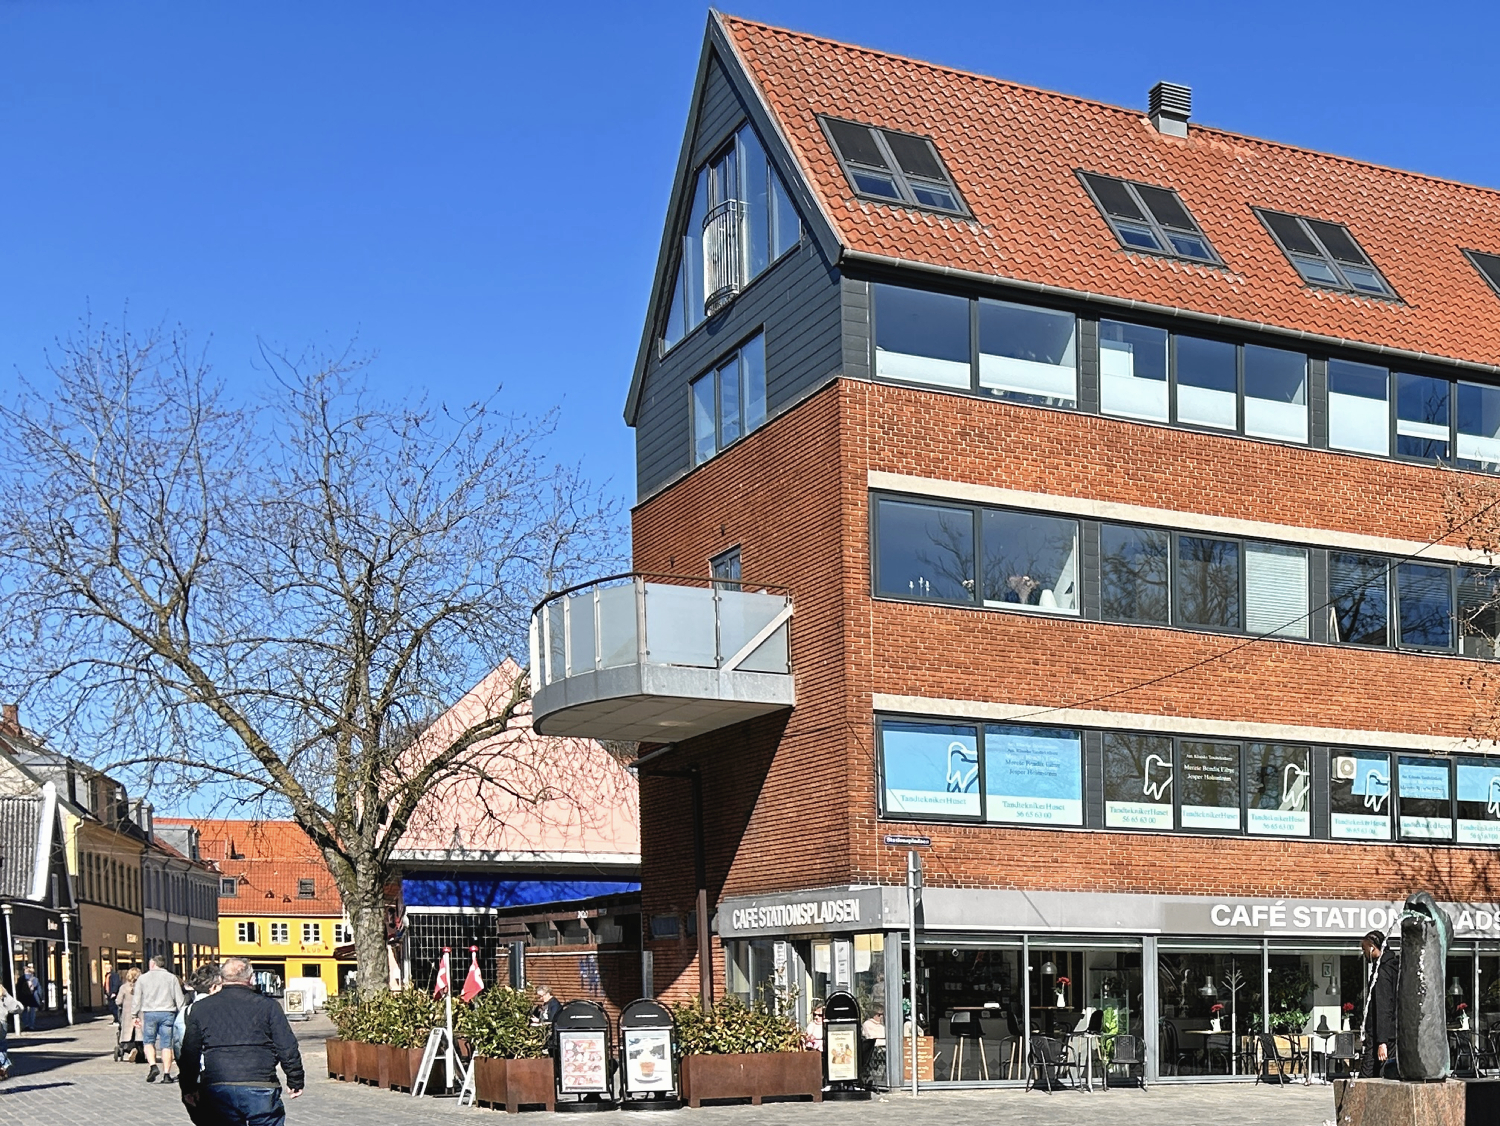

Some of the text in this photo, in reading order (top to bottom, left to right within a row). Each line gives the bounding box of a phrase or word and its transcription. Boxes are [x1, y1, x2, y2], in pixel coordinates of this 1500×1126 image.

[732, 899, 860, 930] CAFÉ STATIONSPLADSEN
[1211, 901, 1287, 927] CAFÉ
